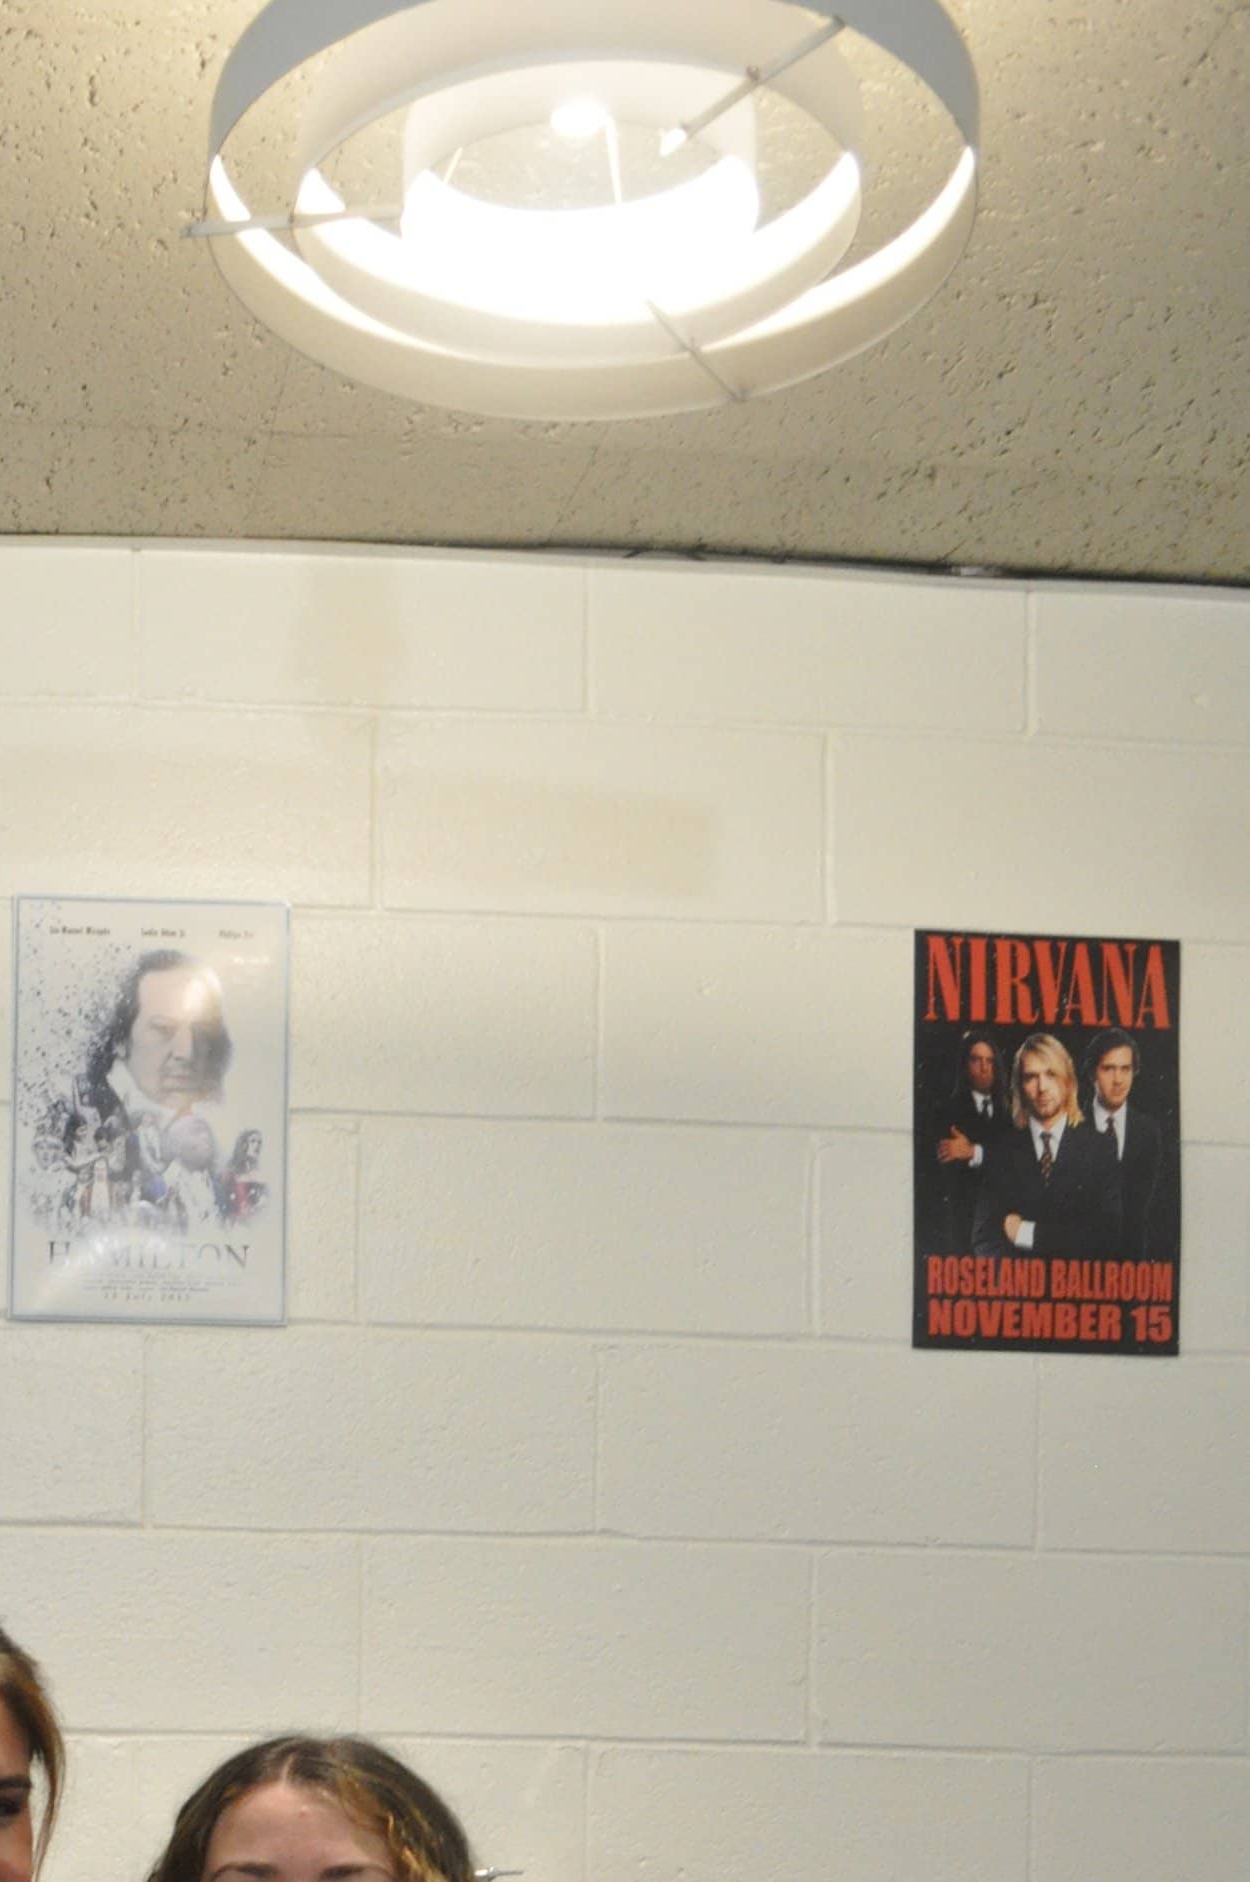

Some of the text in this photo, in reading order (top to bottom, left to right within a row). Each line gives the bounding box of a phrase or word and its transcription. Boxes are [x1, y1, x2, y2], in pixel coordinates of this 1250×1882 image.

[923, 934, 1171, 1030] NIRVANA
[48, 1240, 250, 1269] HMILTON
[927, 1255, 1173, 1303] ROSELAND BALLROOM
[928, 1300, 1173, 1343] NOVEMBER 15
